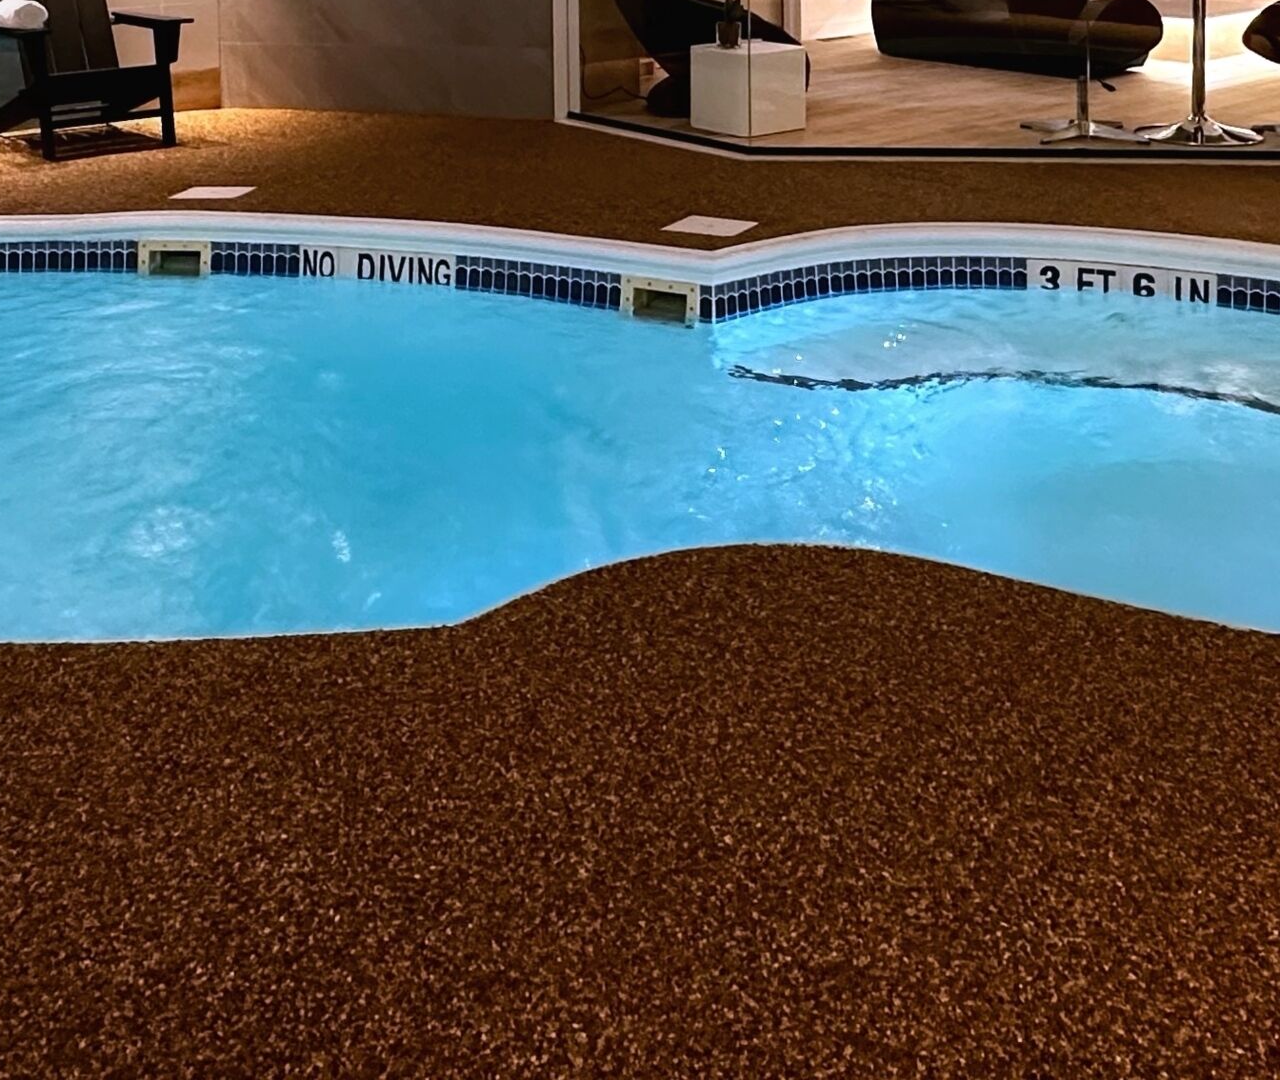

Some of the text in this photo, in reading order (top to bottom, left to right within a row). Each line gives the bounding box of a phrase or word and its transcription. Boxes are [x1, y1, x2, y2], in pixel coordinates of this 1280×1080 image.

[302, 249, 451, 286] NO DIVING
[1039, 265, 1210, 304] 3 FT 6 IN
